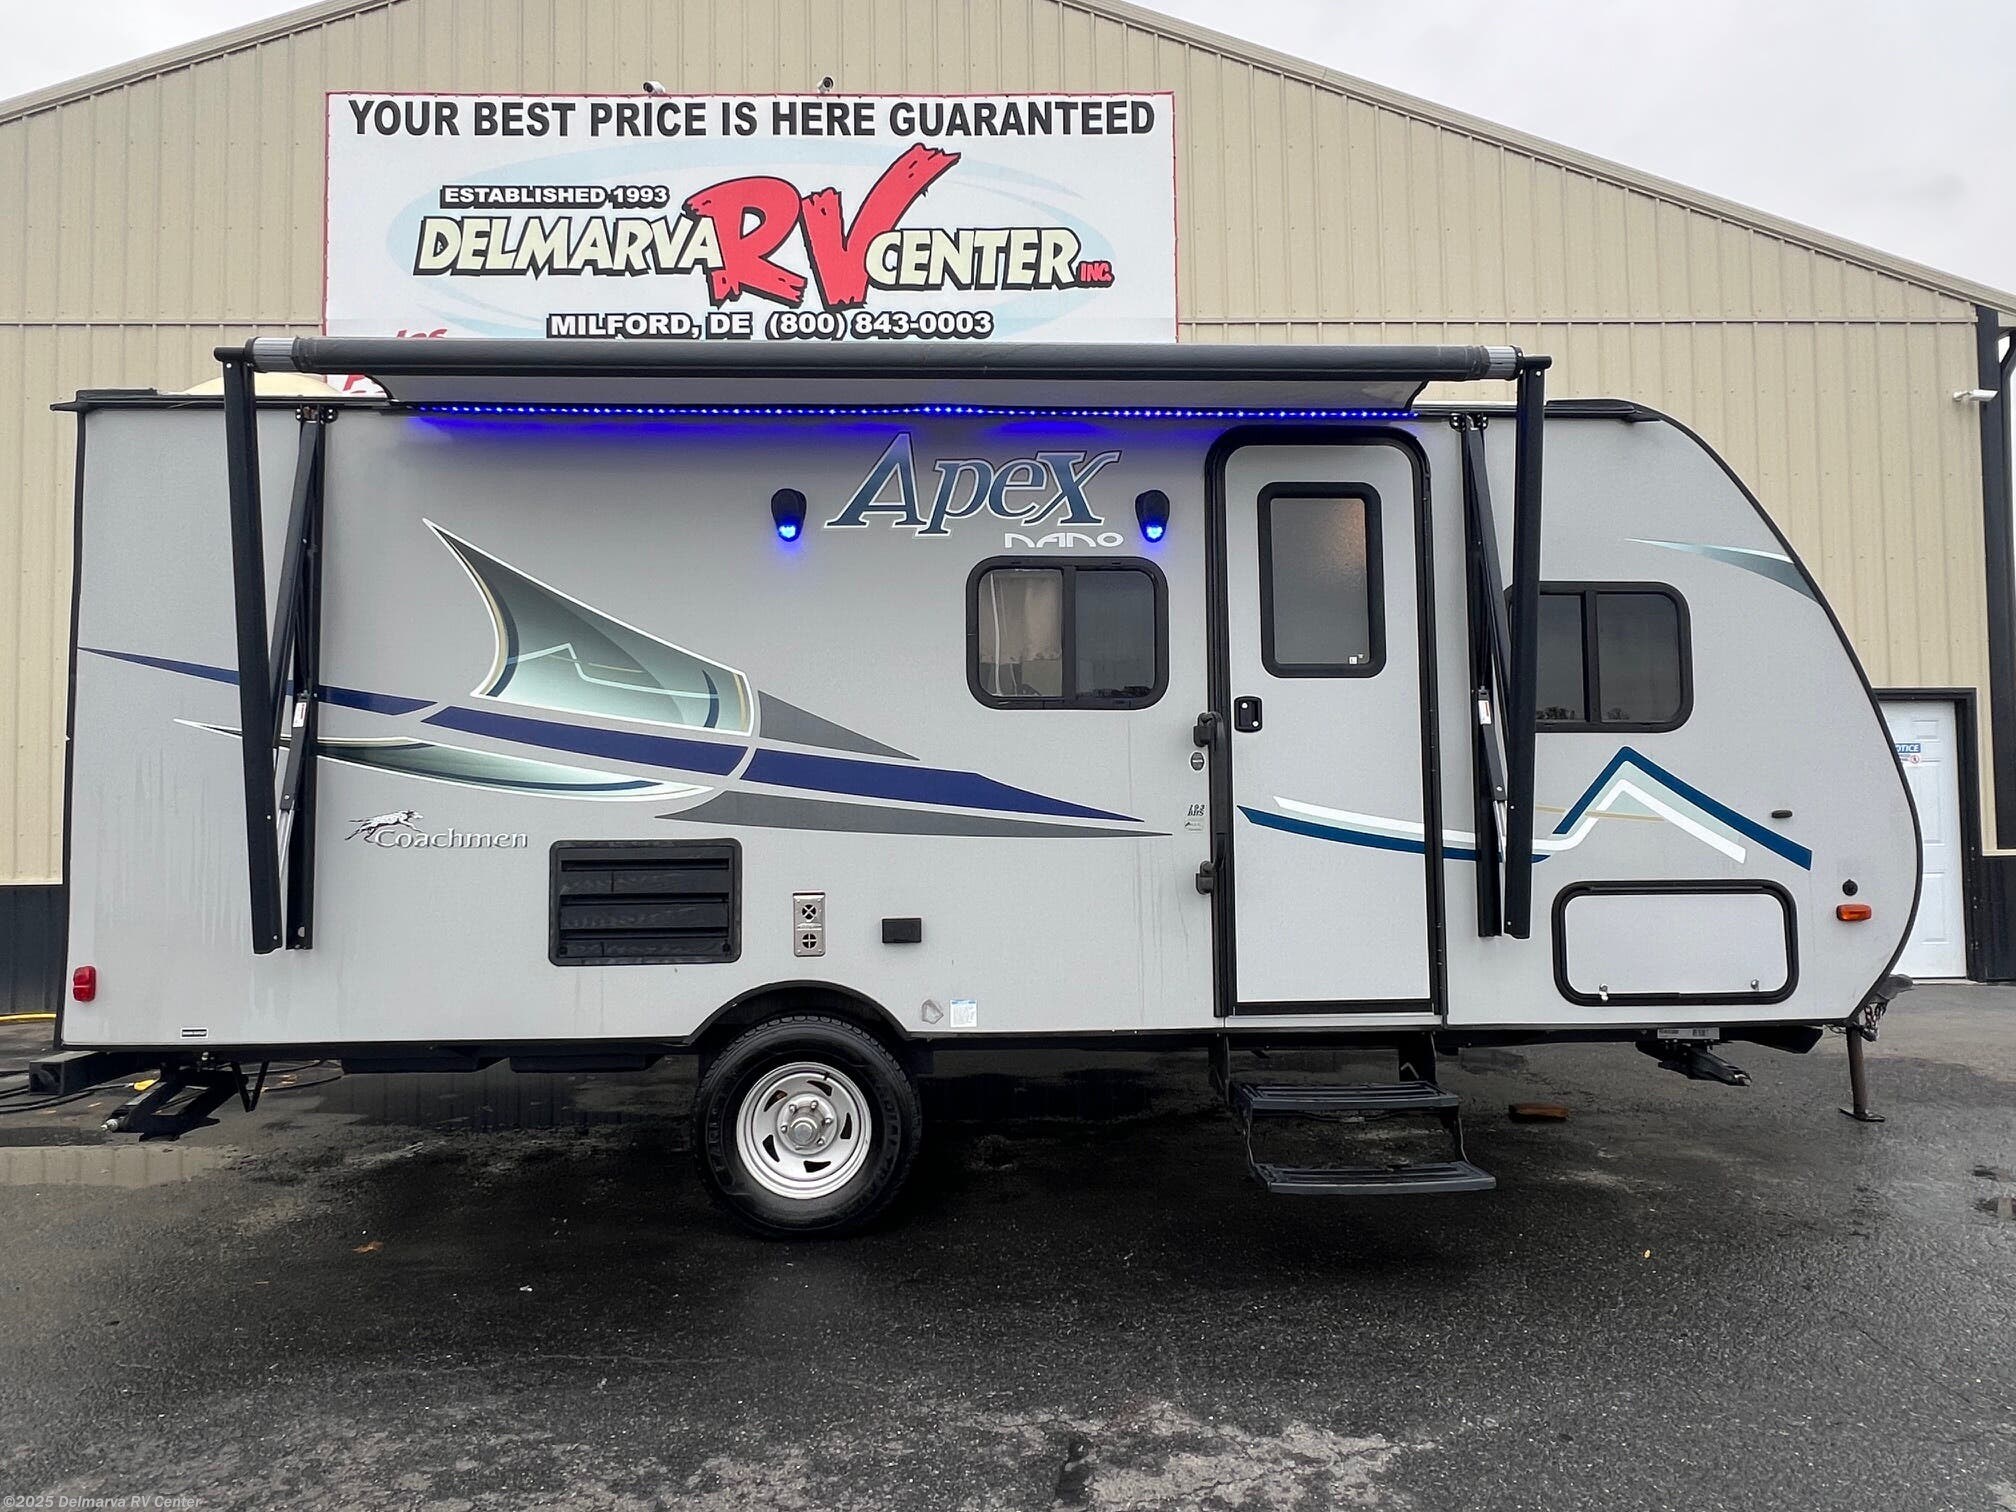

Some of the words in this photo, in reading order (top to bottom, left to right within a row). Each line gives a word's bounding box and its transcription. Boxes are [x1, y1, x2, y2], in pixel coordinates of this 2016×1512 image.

[349, 100, 460, 136] YOUR
[474, 102, 575, 136] BEST
[590, 102, 706, 136] PRICE
[722, 102, 757, 136] IS
[771, 102, 876, 136] HERE
[889, 101, 1154, 136] GUARANTEED
[444, 188, 605, 204] ESTABLISHED
[613, 187, 668, 204] 1993
[413, 215, 724, 277] DELMARVA
[681, 143, 961, 309] RV
[865, 227, 1081, 290] CENTER
[1078, 262, 1113, 286] INC.
[549, 315, 700, 338] MILFORD,
[710, 314, 752, 335] DE
[769, 313, 846, 339] (800)
[854, 313, 993, 335] 843-0003
[1896, 744, 1919, 752] OTICE
